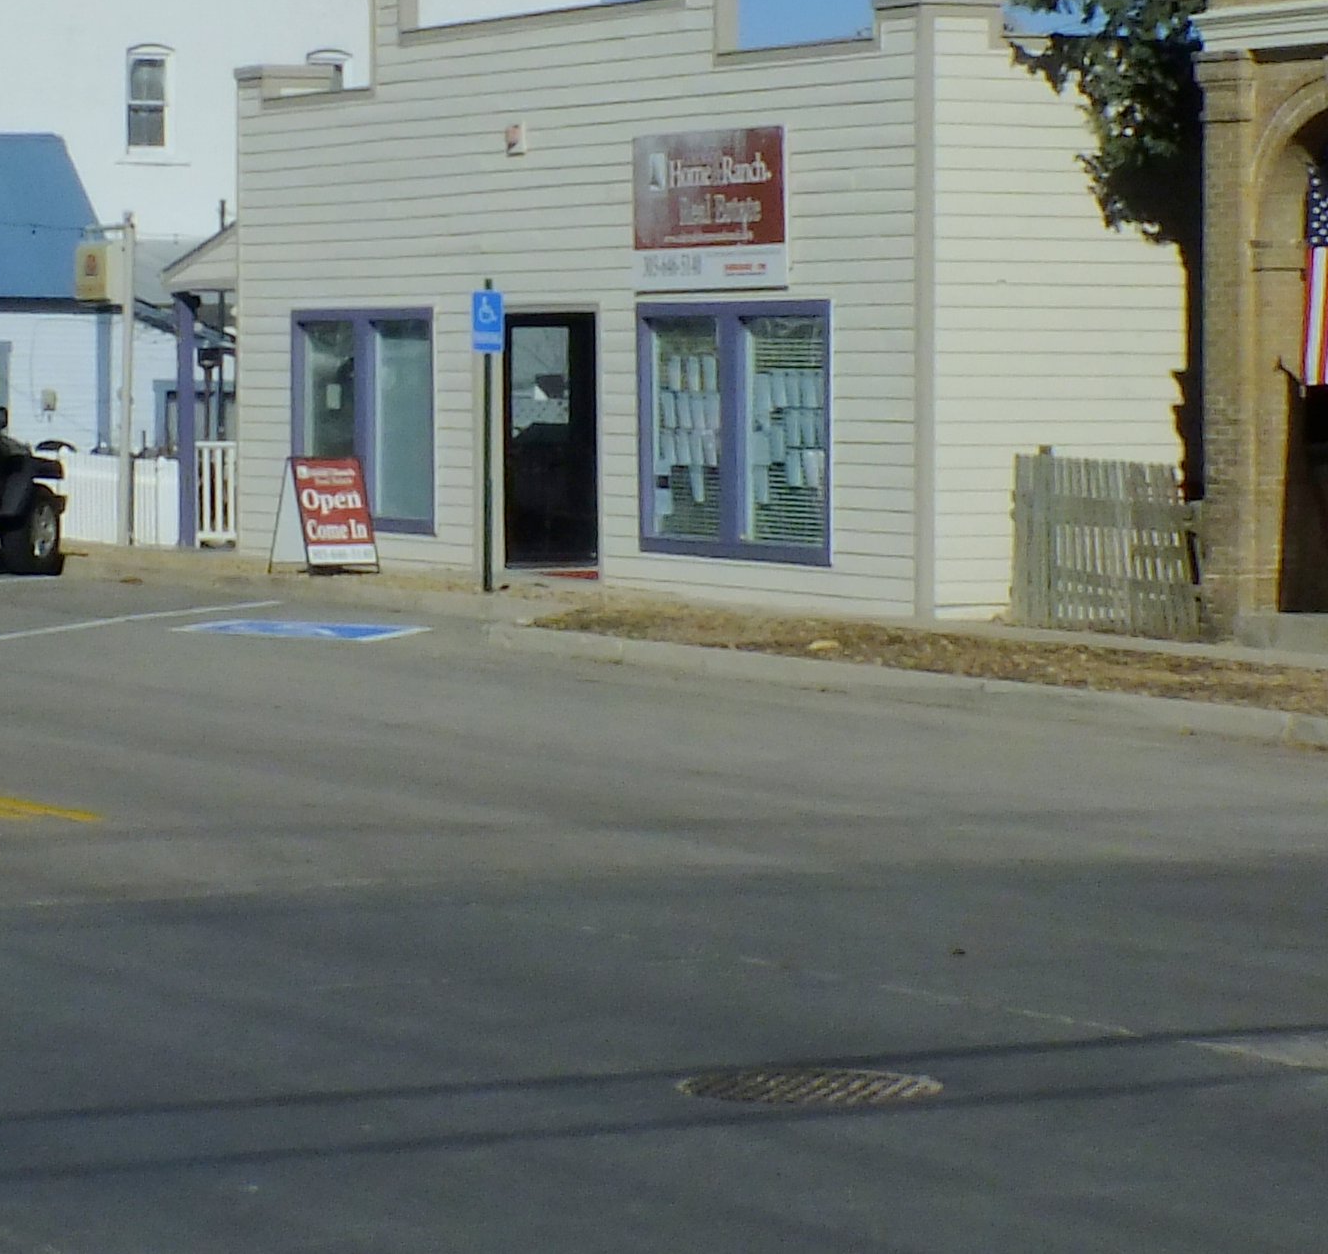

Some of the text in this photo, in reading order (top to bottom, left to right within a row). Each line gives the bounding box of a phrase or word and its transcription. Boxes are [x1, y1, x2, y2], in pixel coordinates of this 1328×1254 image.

[301, 488, 363, 515] Open
[306, 518, 369, 541] Come In
